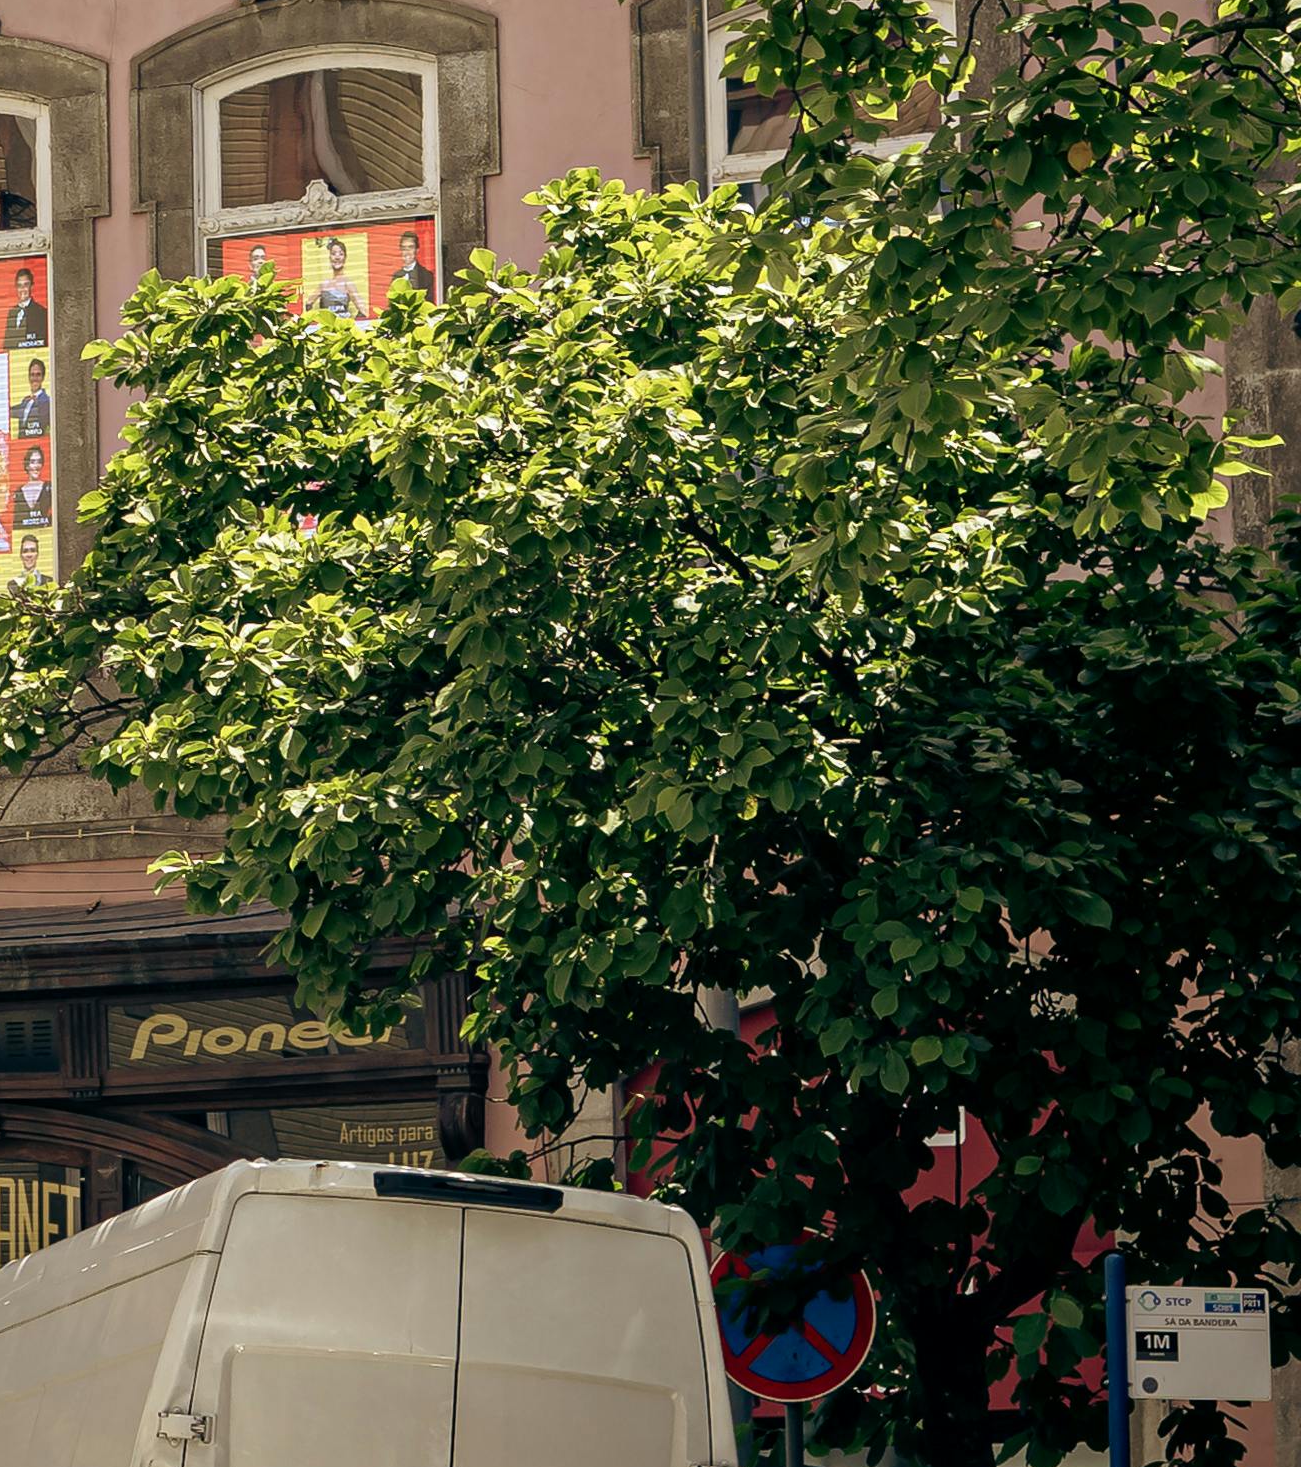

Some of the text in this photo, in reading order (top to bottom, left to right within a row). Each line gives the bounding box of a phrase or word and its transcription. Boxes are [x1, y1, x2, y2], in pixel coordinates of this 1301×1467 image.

[340, 1123, 433, 1148] Artigos para
[1165, 1298, 1192, 1306] STCP
[1179, 1318, 1191, 1326] DA
[1193, 1319, 1237, 1327] BANDEIRA
[1143, 1334, 1171, 1350] 1M
